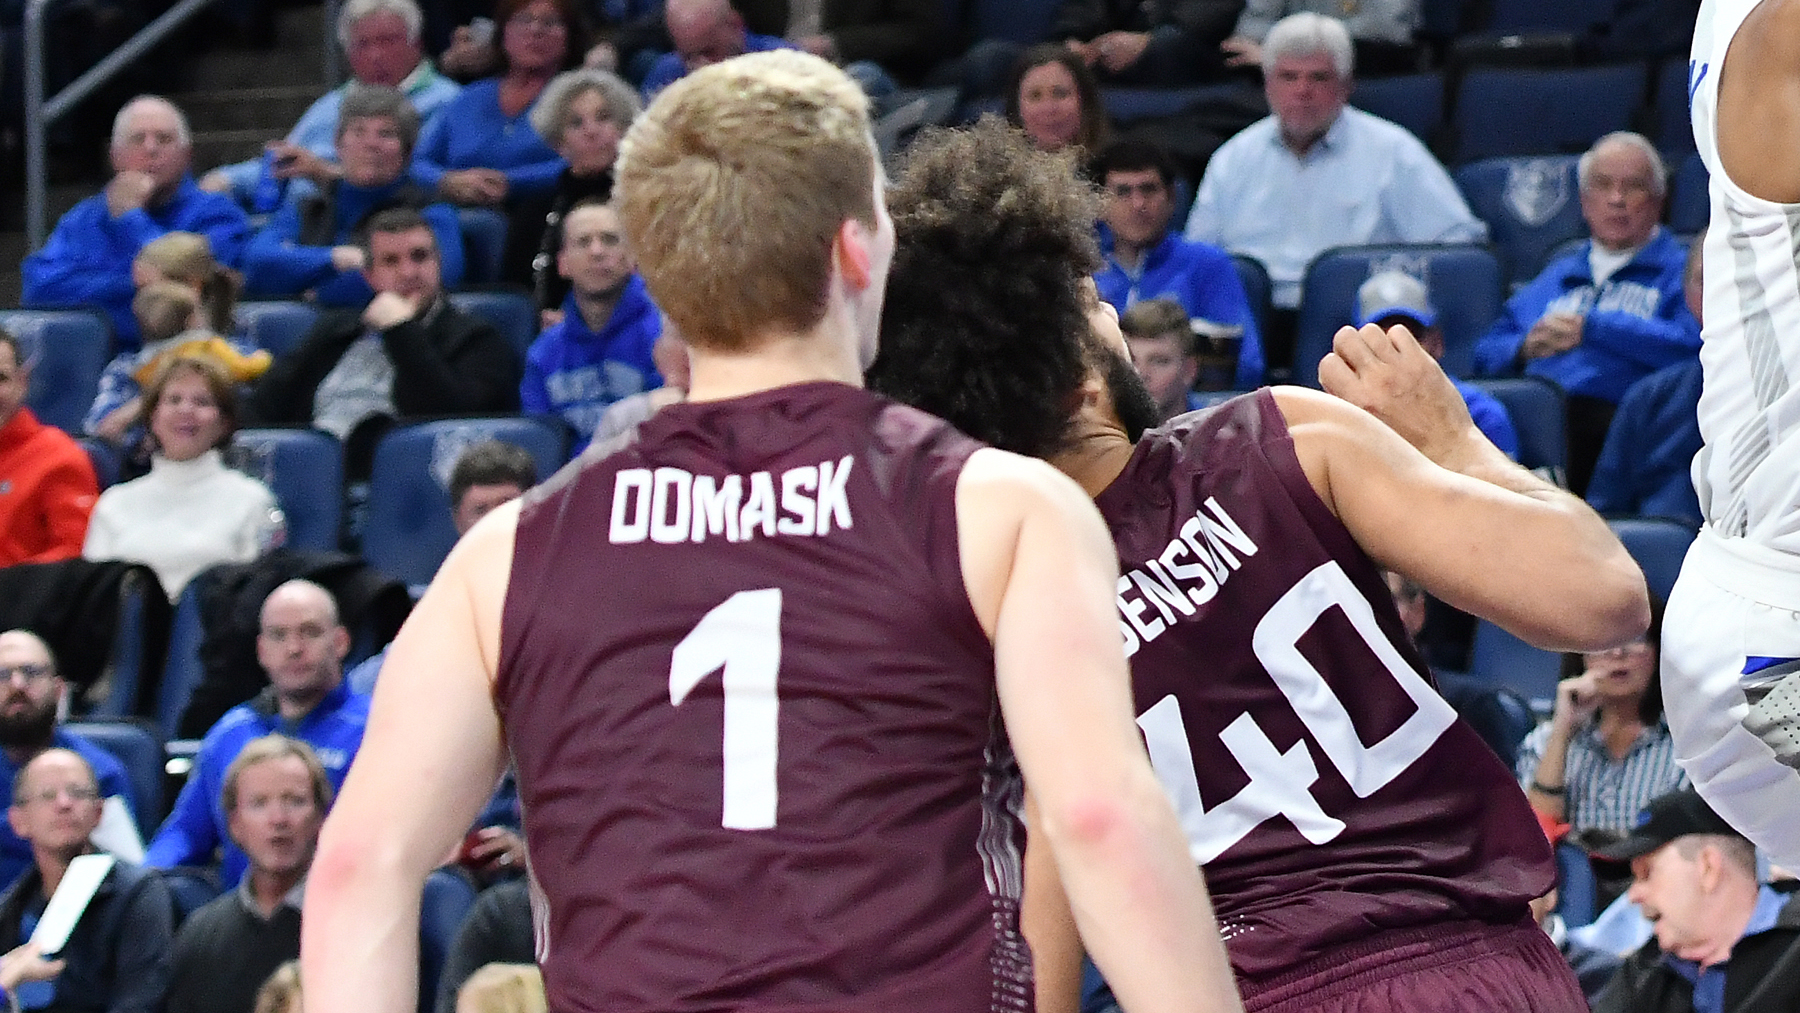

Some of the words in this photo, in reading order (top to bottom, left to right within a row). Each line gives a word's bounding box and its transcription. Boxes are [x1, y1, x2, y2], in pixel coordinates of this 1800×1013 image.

[609, 455, 854, 544] DOMASK
[669, 588, 782, 830] 1
[1136, 560, 1458, 866] 40
